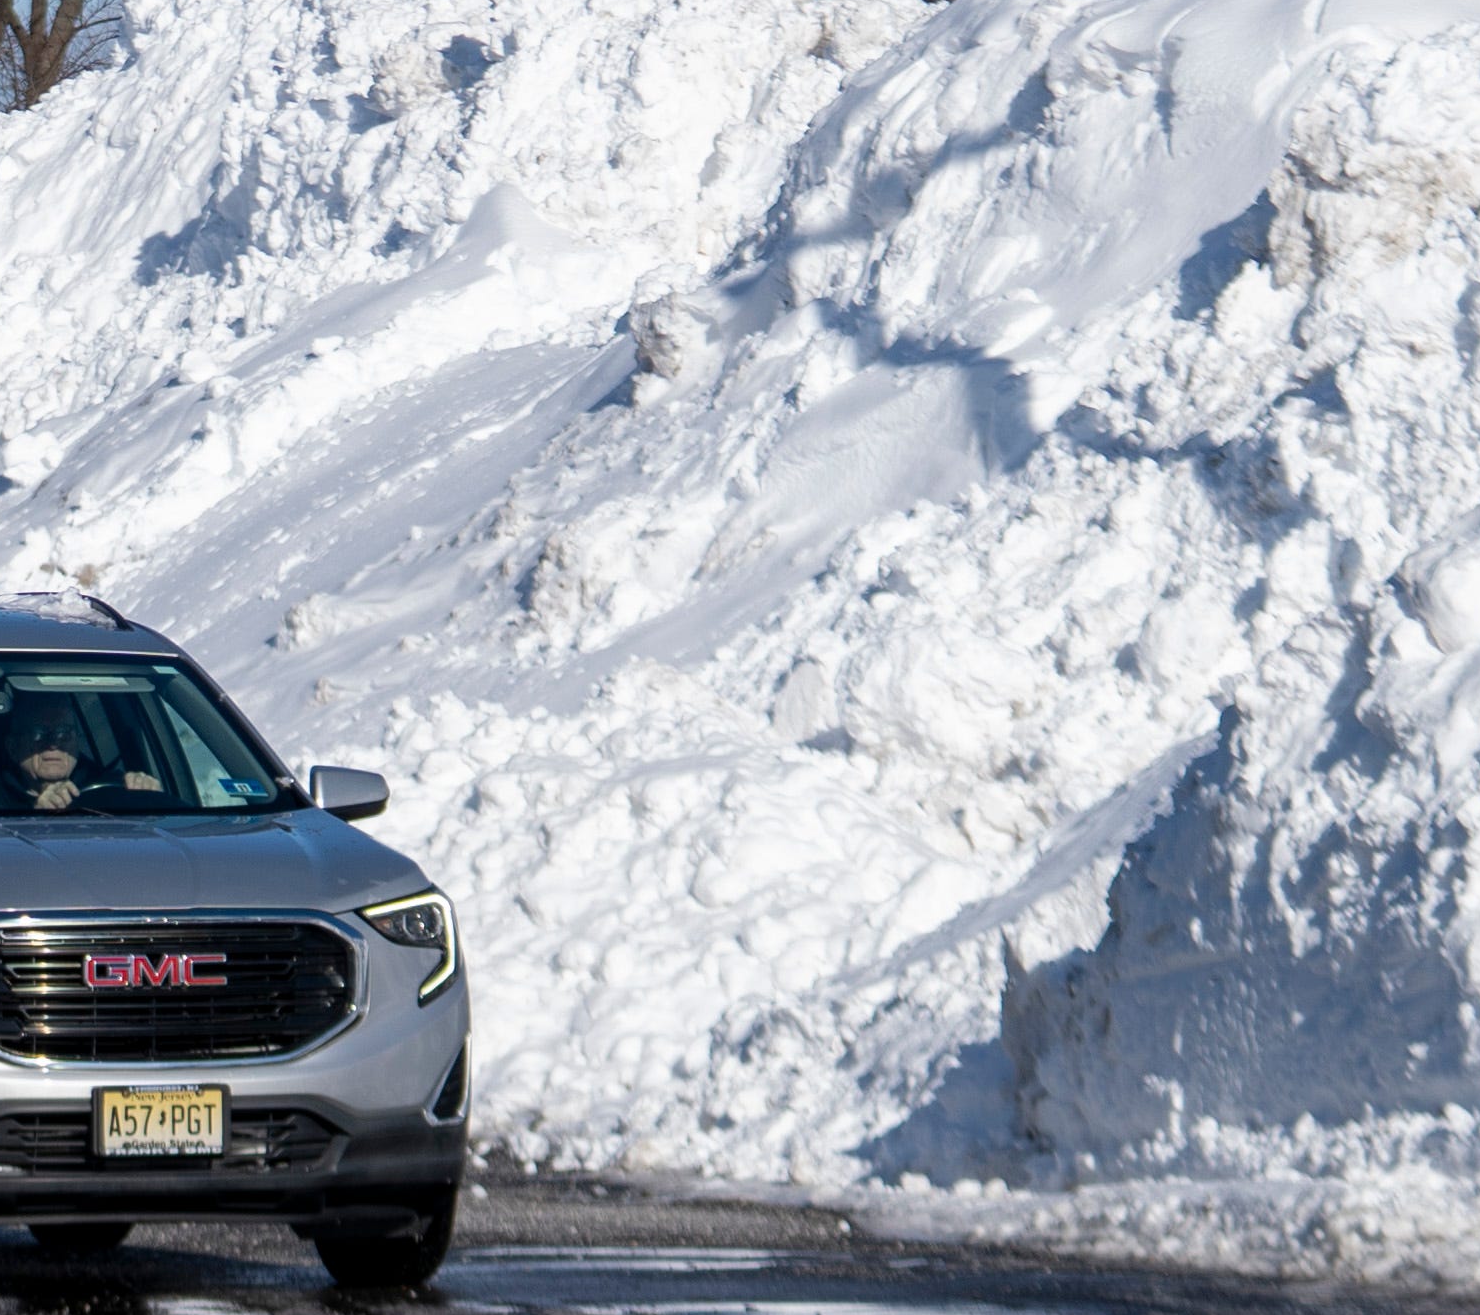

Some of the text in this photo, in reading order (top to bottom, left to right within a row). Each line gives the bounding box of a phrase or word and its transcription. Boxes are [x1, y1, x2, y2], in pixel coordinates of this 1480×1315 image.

[83, 953, 228, 987] GMC
[131, 1092, 194, 1103] New Jersey
[109, 1104, 217, 1137] A57 PGT
[132, 1140, 195, 1150] Garden State
